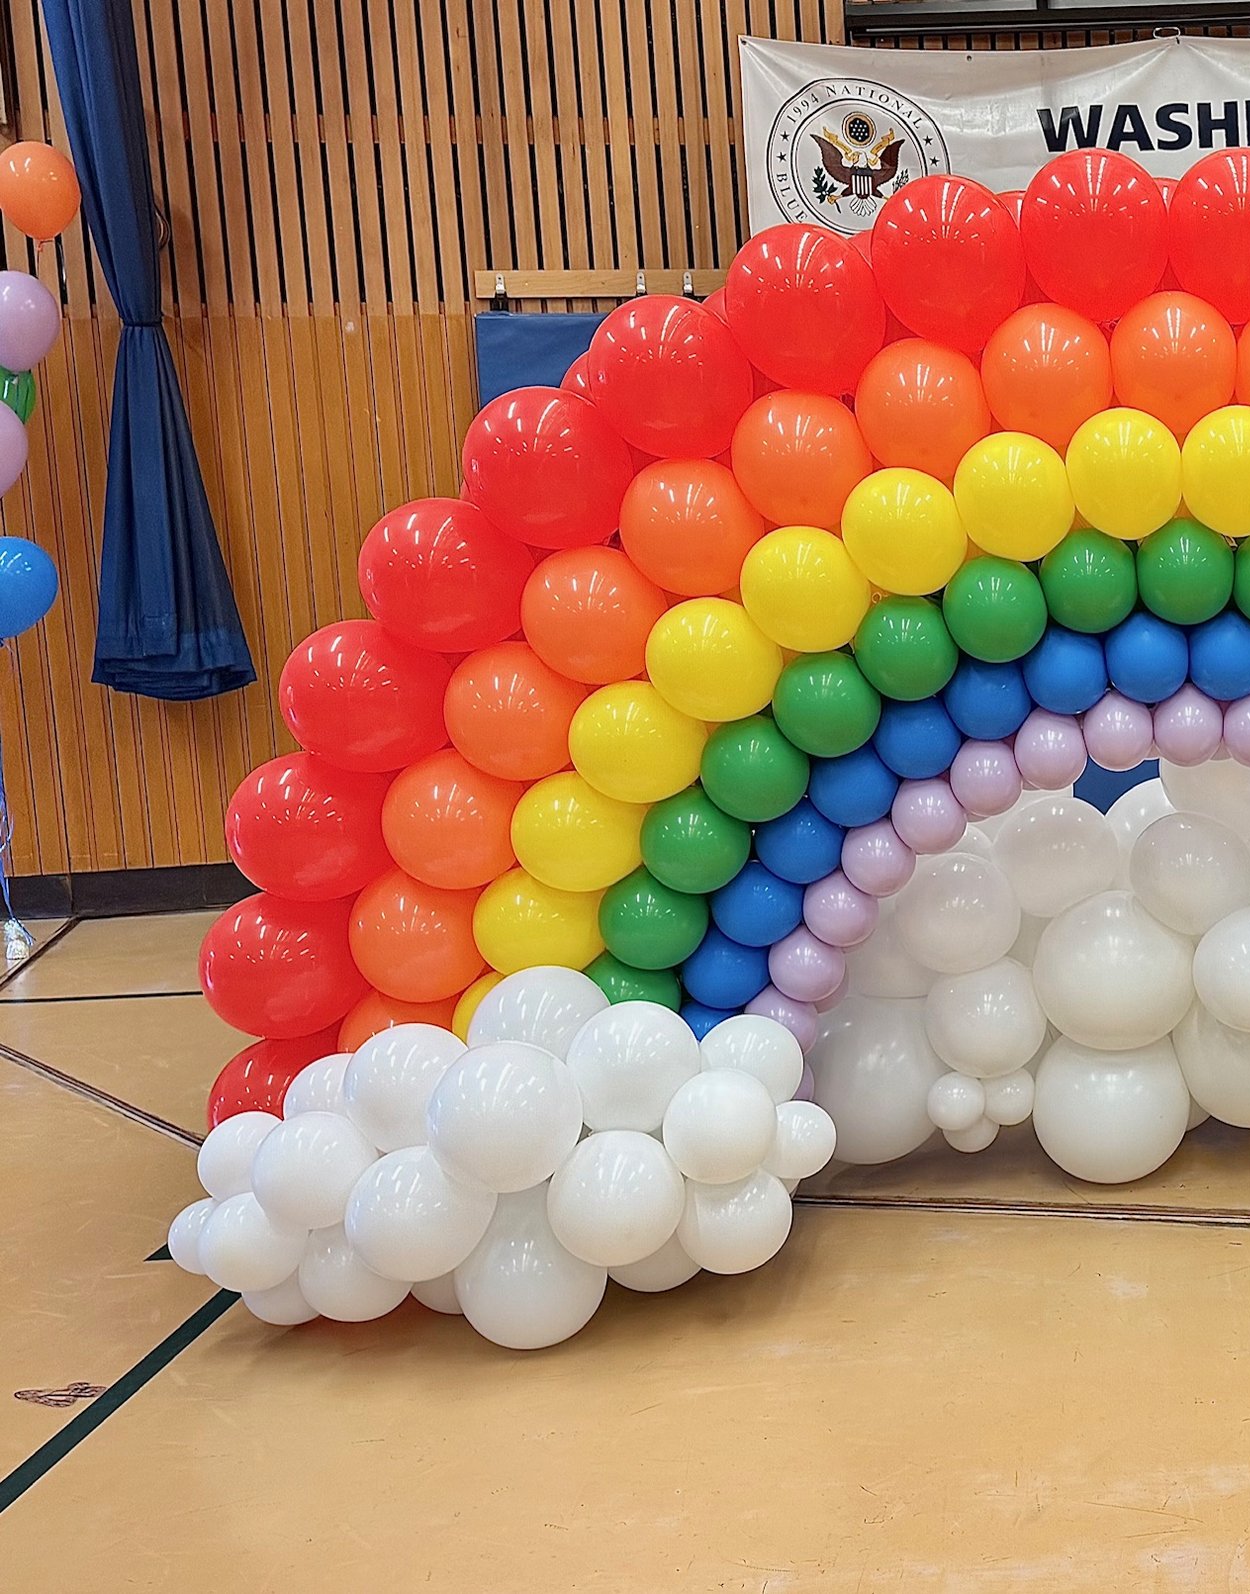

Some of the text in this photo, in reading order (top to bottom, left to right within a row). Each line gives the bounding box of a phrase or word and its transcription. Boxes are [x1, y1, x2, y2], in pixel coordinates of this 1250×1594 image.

[786, 84, 923, 130] 1994 NATIONAL
[776, 173, 808, 224] BLUE
